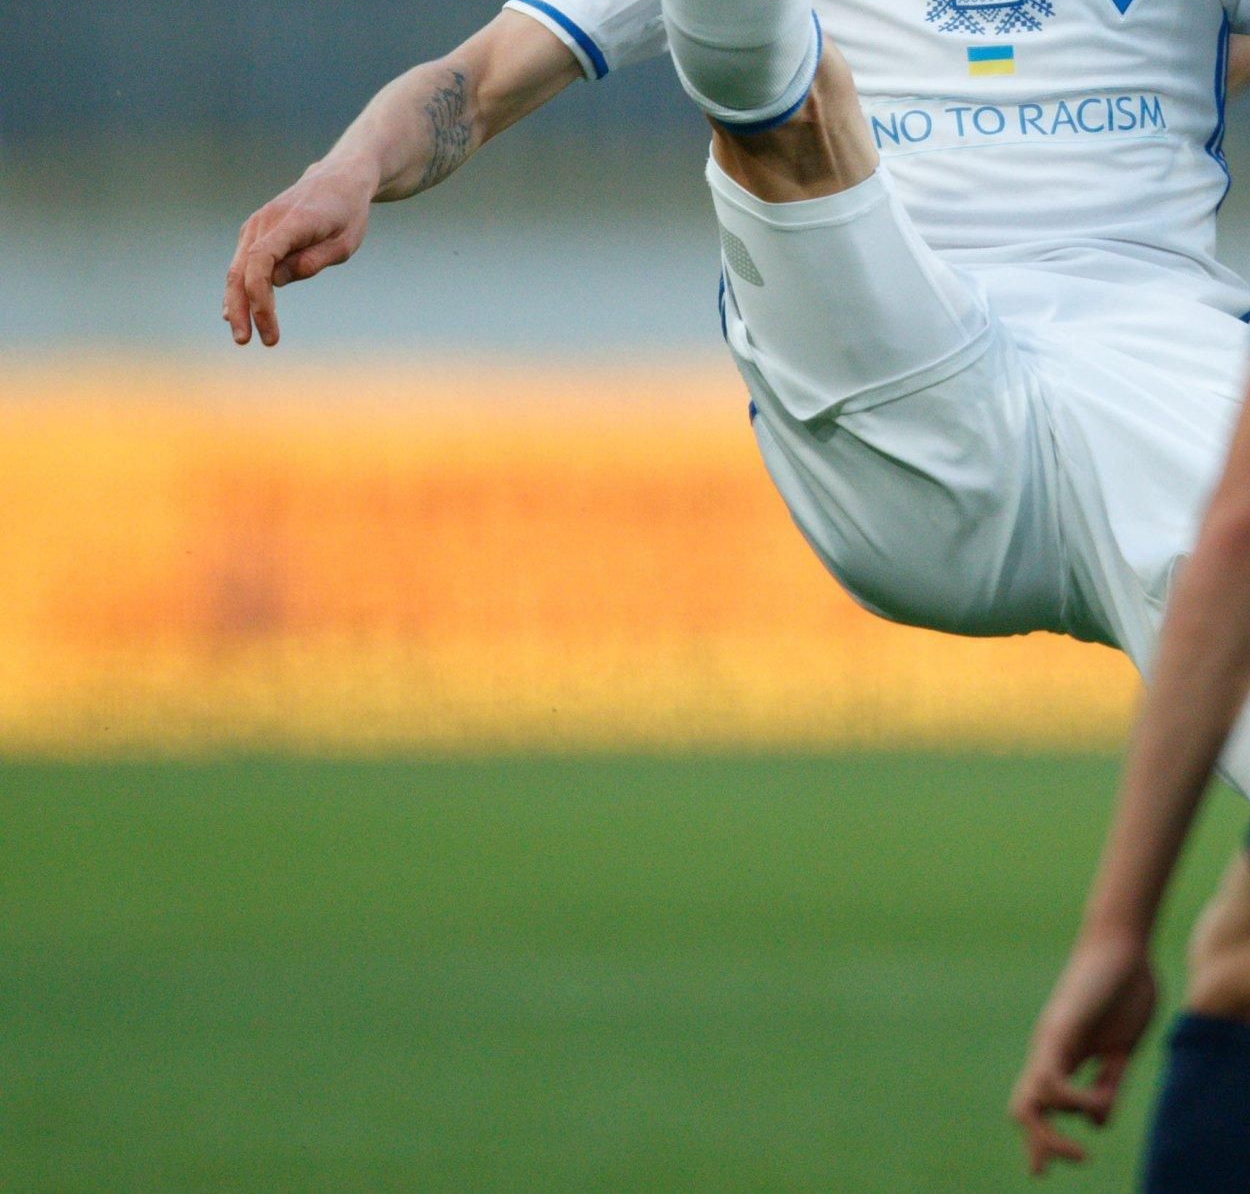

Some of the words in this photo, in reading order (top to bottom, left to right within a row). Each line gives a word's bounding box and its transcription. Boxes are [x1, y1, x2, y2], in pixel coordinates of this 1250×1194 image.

[871, 109, 932, 148] NO
[945, 106, 1006, 137] TO
[1018, 96, 1167, 135] RACISM
